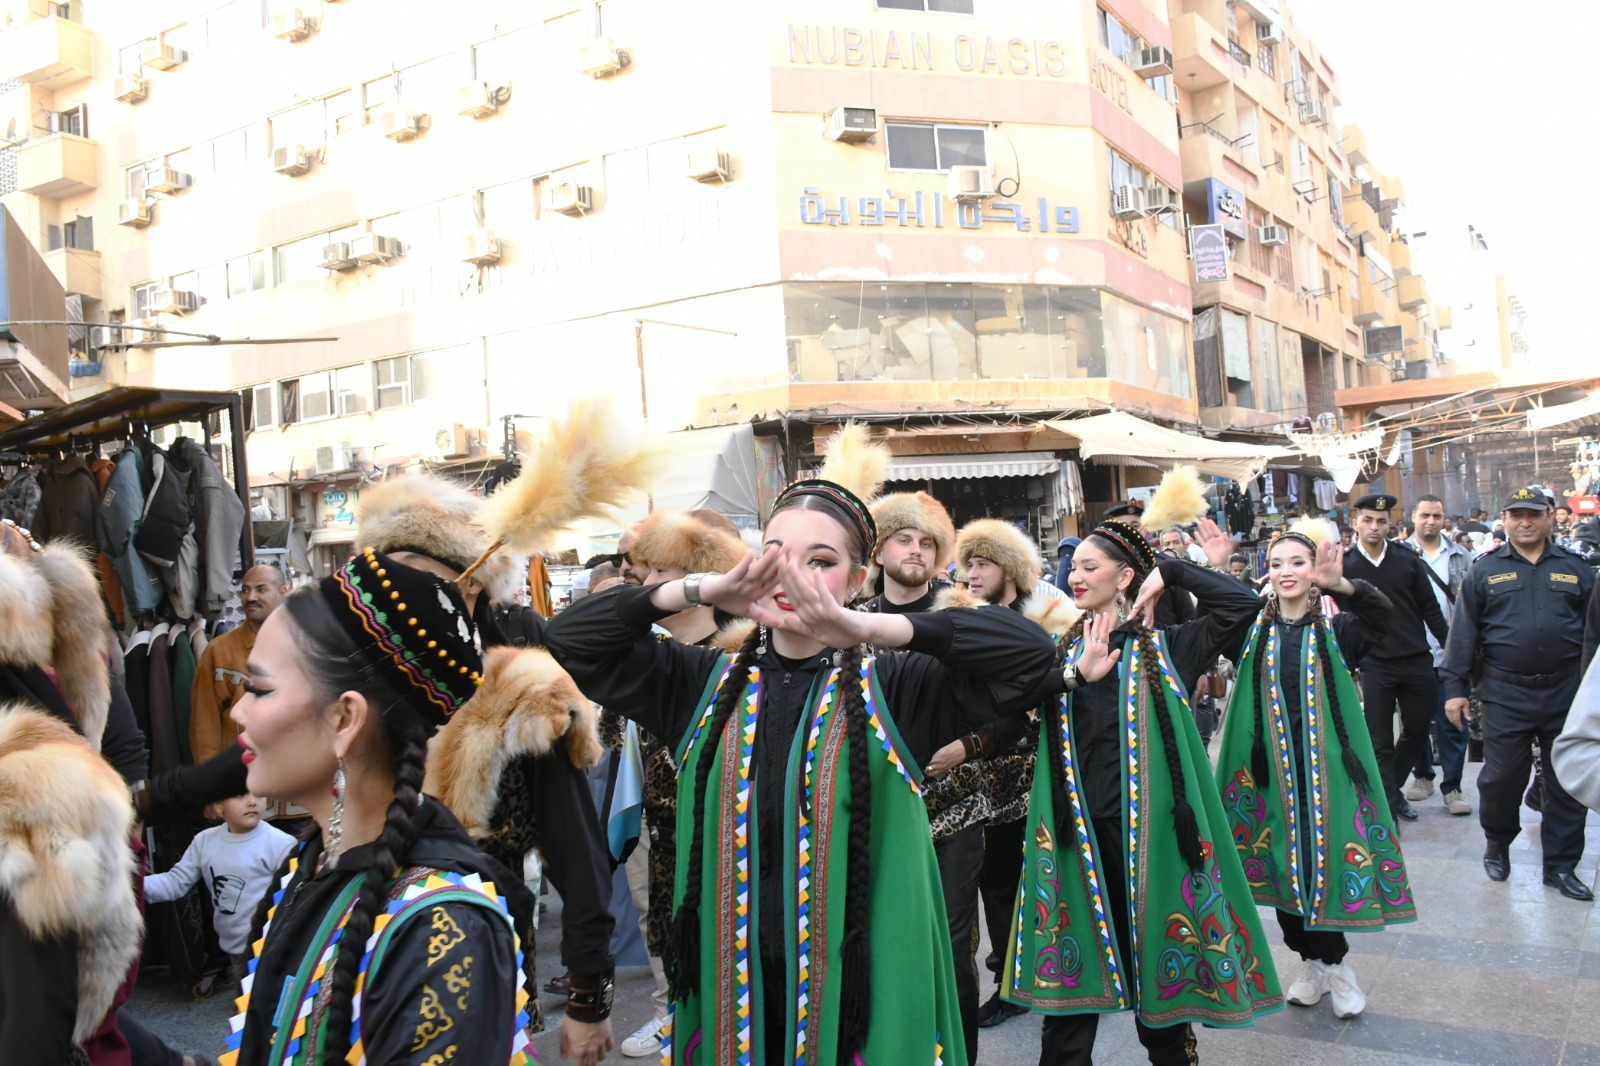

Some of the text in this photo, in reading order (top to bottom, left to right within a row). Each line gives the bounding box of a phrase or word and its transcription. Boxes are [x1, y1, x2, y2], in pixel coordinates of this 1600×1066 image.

[787, 23, 1068, 78] NUBIAN OASIS
[1086, 47, 1134, 116] HOTEL
